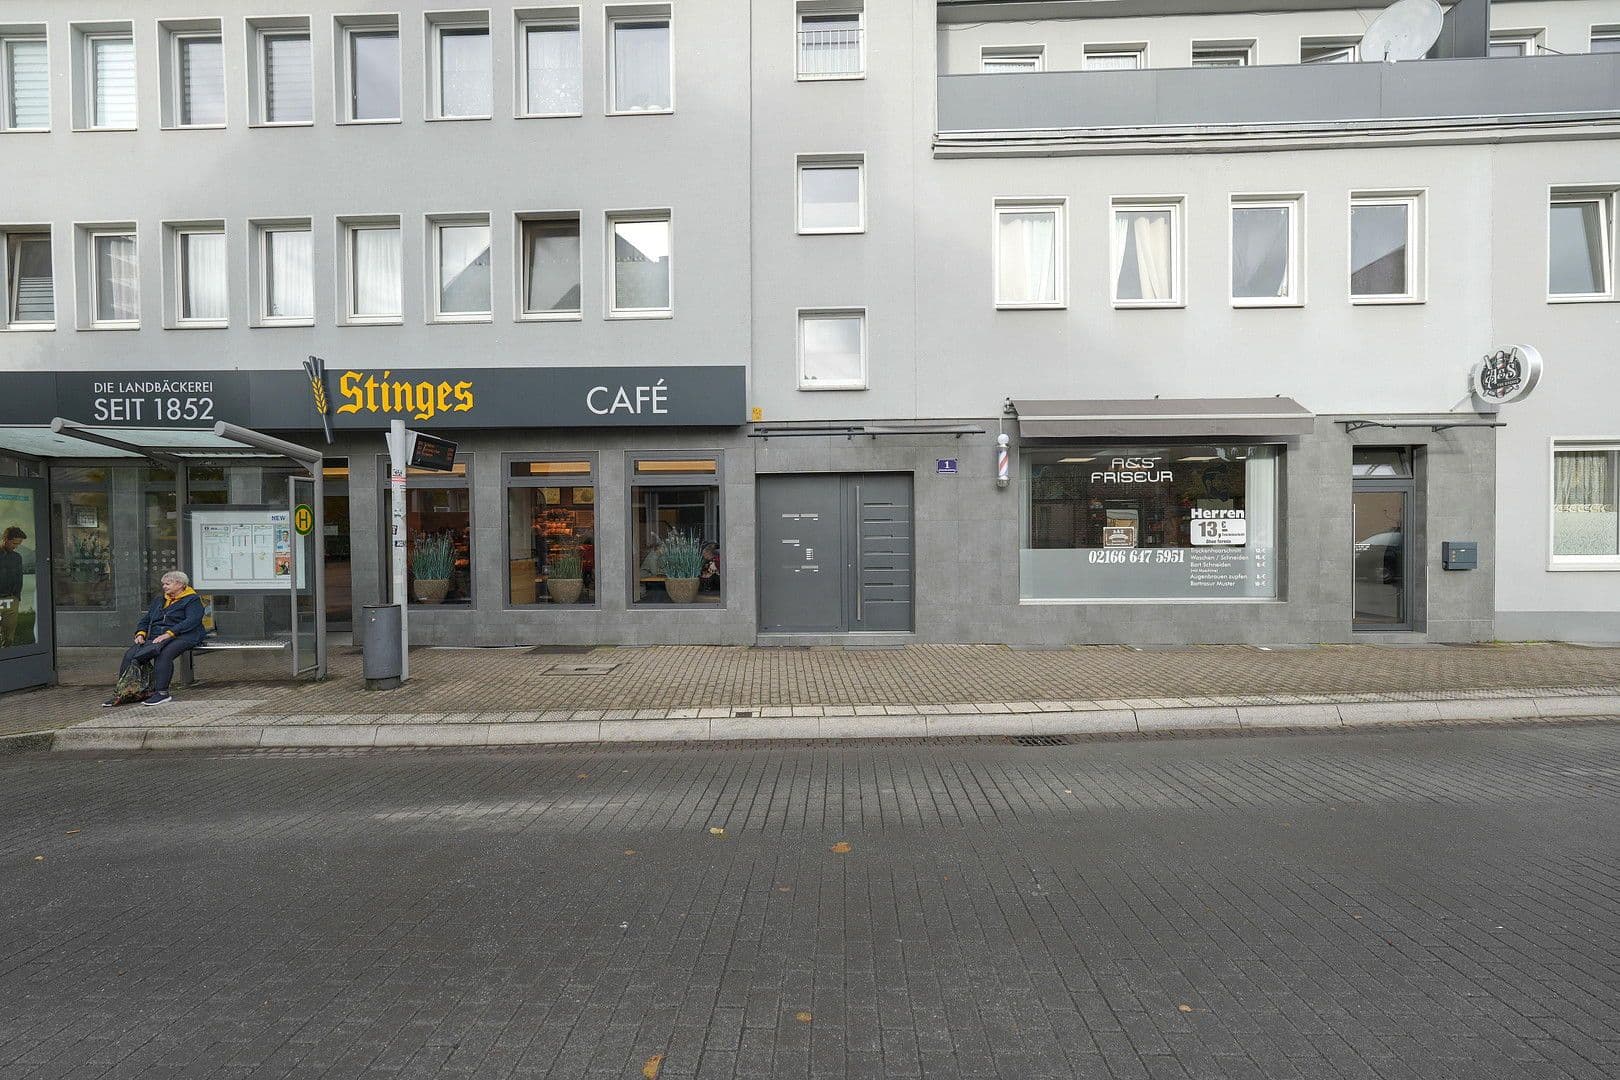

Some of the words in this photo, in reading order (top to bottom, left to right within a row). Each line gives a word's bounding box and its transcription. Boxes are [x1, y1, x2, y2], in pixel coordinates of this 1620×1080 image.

[94, 382, 114, 393] DIE
[119, 379, 213, 393] LANDBÄCKEREI
[336, 370, 474, 420] Stinges
[586, 378, 668, 415] CAFÉ
[94, 398, 145, 420] SEIT
[154, 397, 214, 420] 1852
[1111, 457, 1155, 469] A&S
[1091, 471, 1173, 483] FRISEUR
[298, 511, 308, 529] H
[1190, 508, 1245, 519] Herren
[1088, 550, 1126, 563] 02166
[1129, 550, 1153, 563] 647
[1156, 549, 1185, 563] 5951
